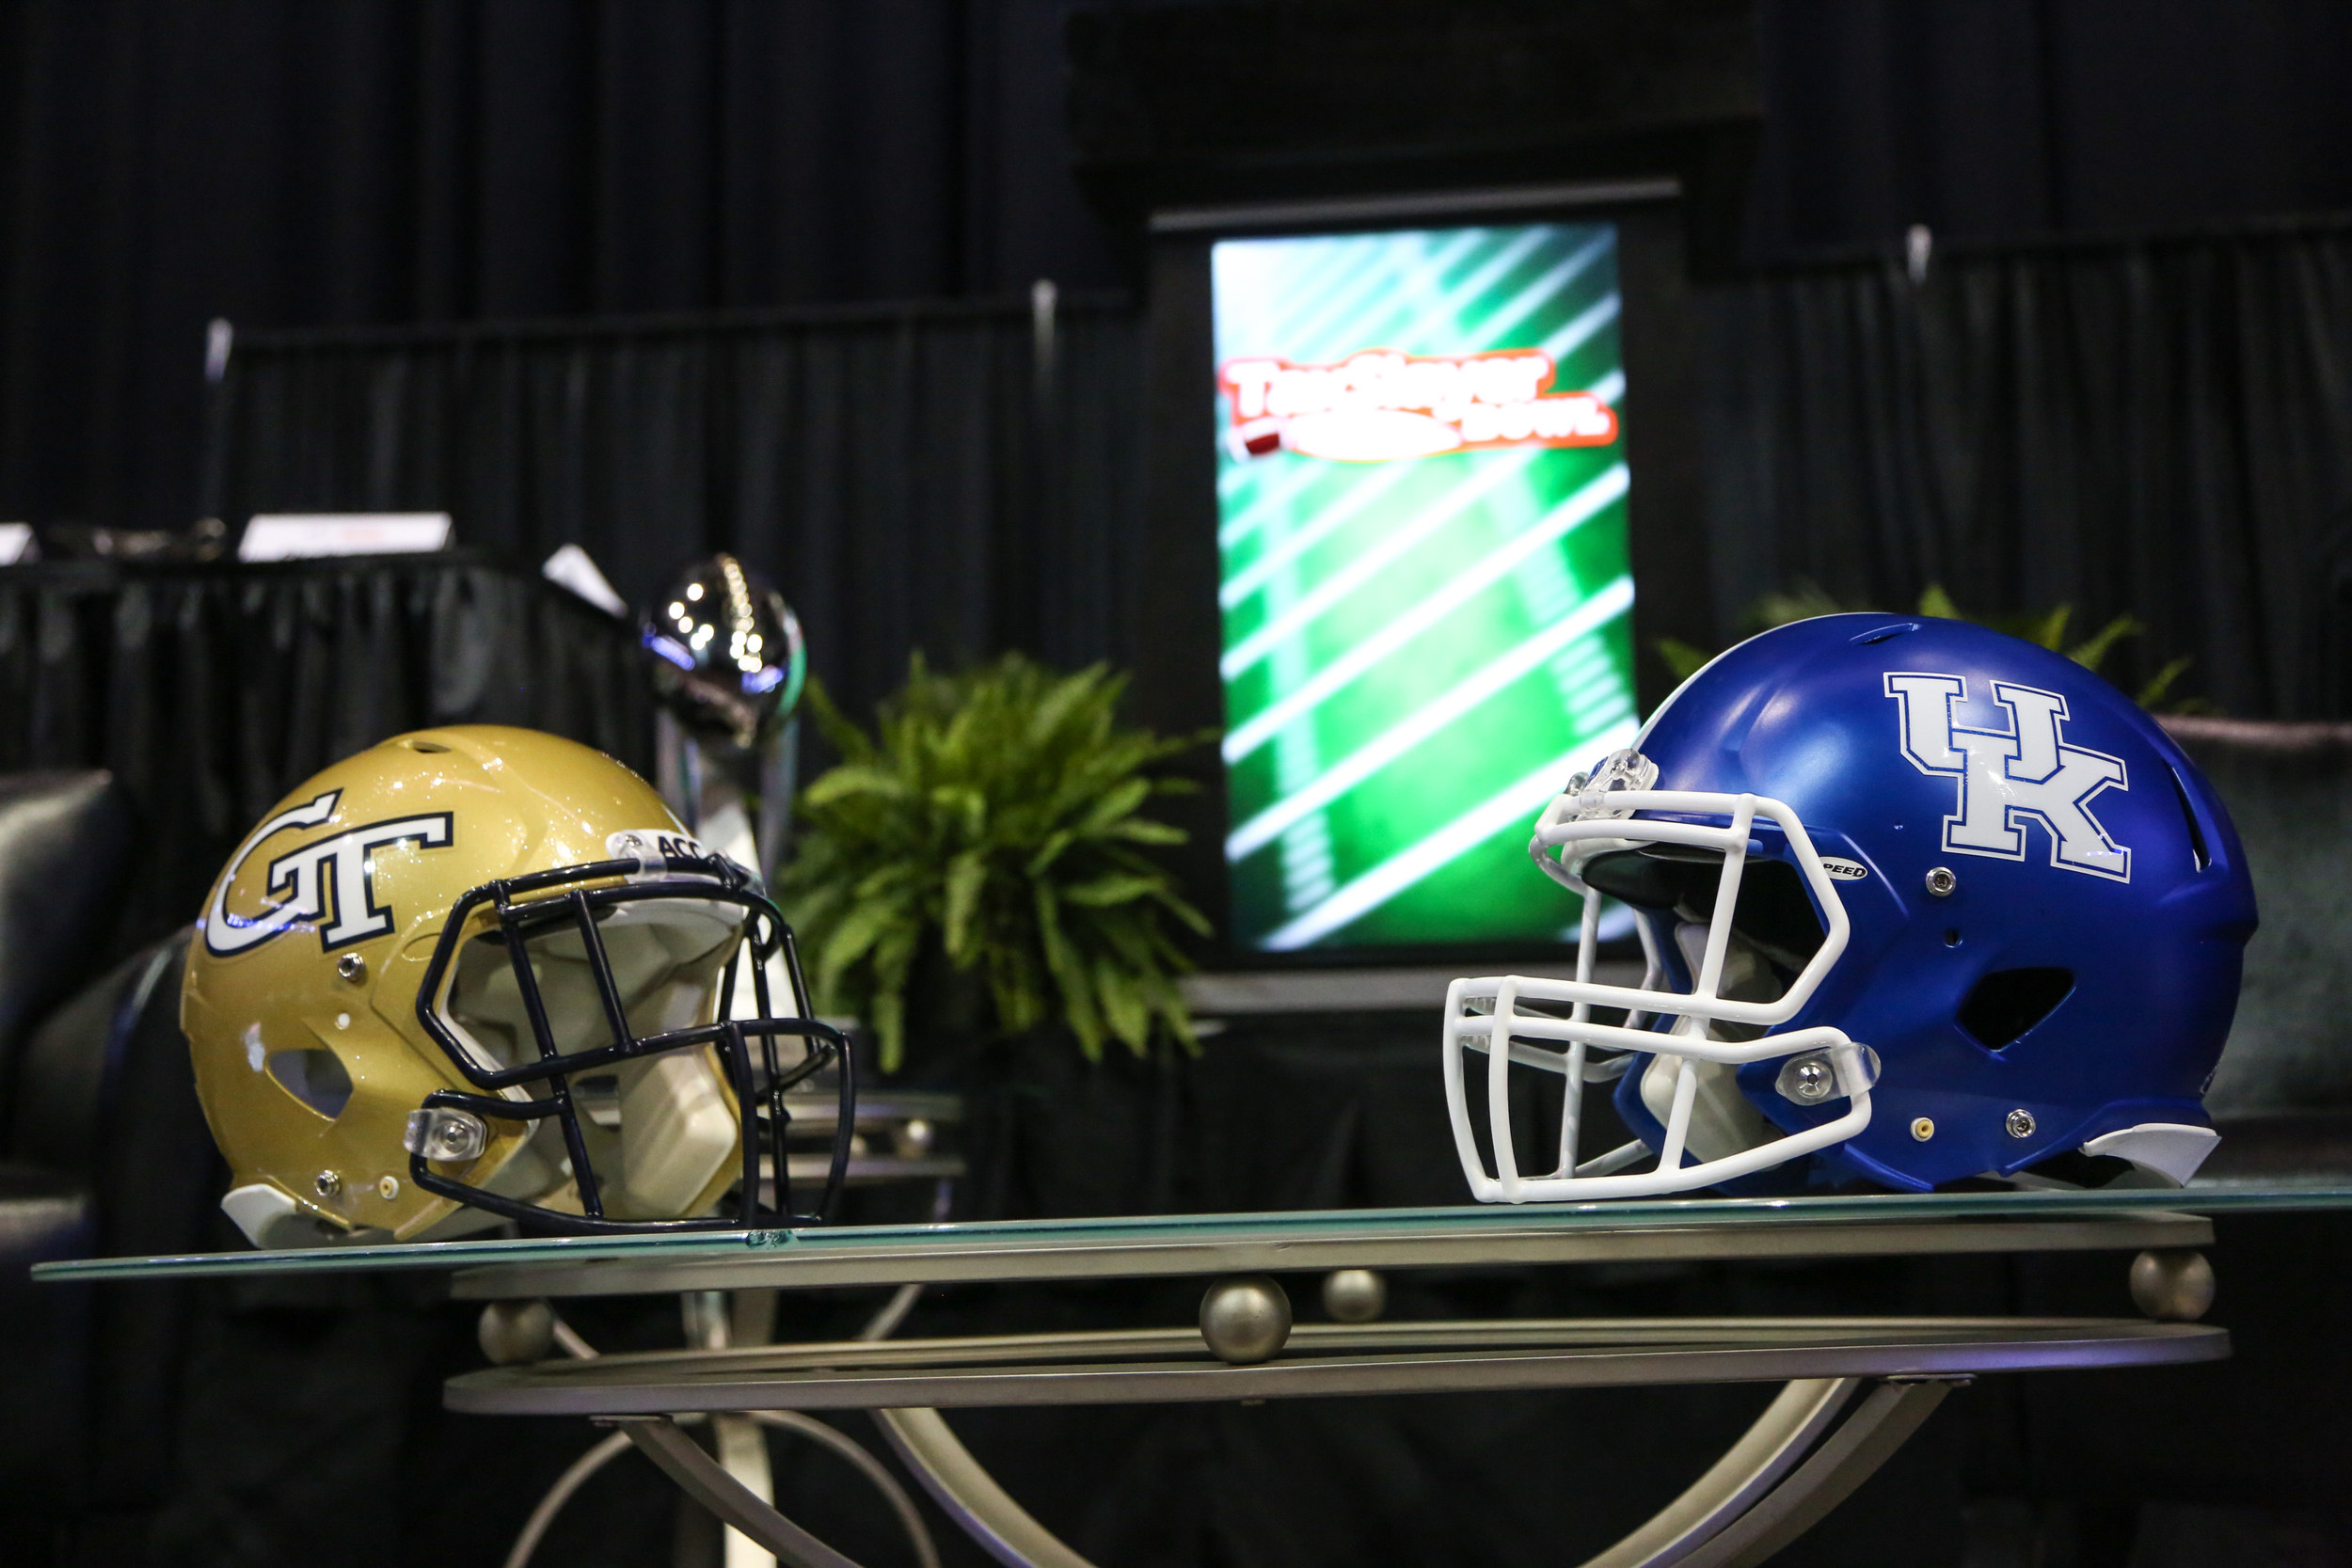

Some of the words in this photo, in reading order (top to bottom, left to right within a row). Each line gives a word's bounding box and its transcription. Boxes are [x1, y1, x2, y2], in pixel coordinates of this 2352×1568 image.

[1883, 672, 2131, 883] UK
[205, 787, 453, 958] GT
[659, 835, 702, 860] ACC
[1822, 863, 1867, 878] PEED
